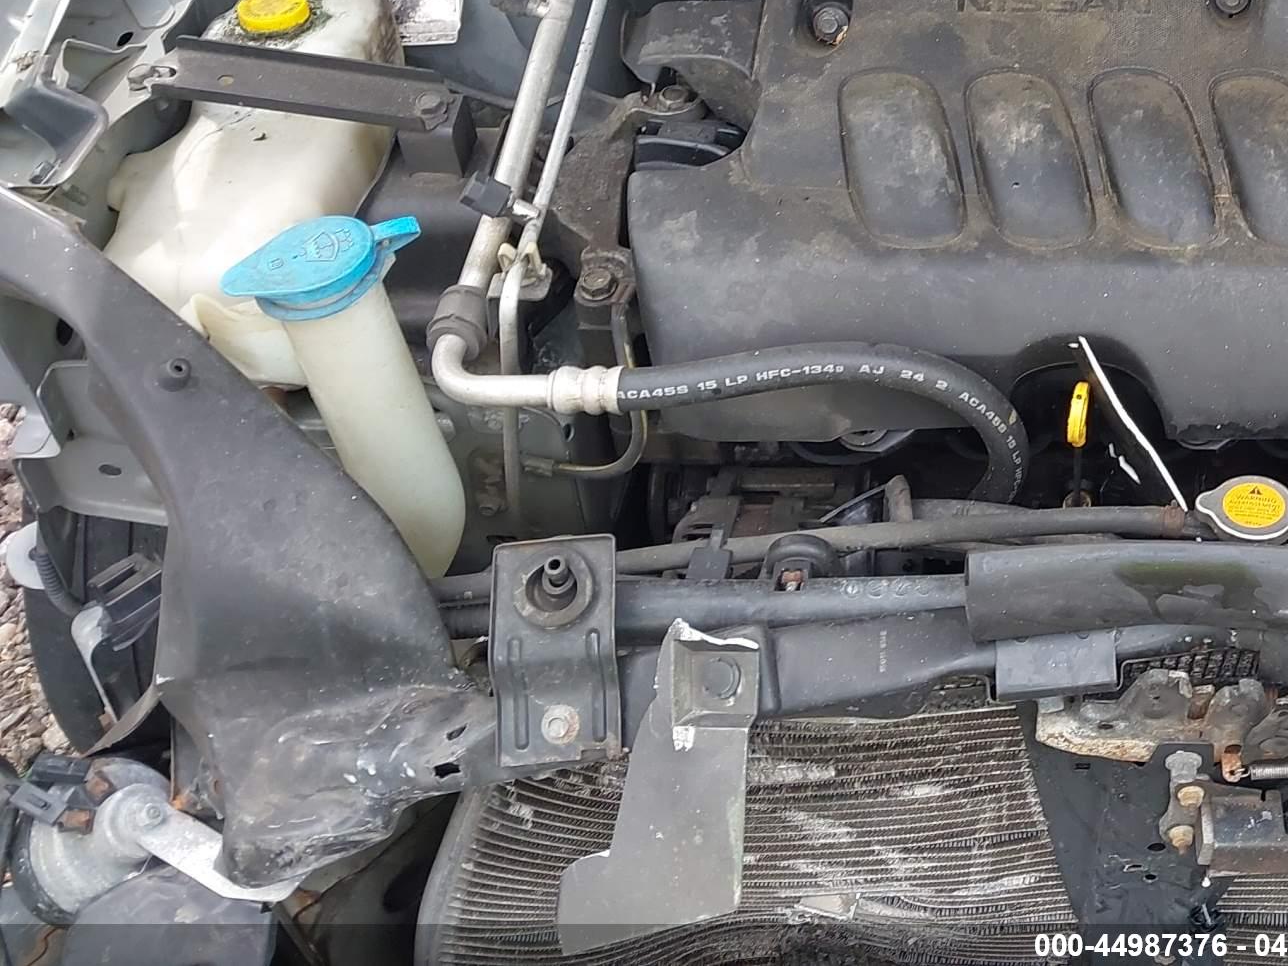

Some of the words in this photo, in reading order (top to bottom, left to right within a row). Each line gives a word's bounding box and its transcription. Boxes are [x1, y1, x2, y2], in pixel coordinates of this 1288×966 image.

[696, 379, 717, 391] 15
[725, 375, 748, 387] LP
[859, 364, 885, 375] AJ
[900, 369, 926, 383] 24
